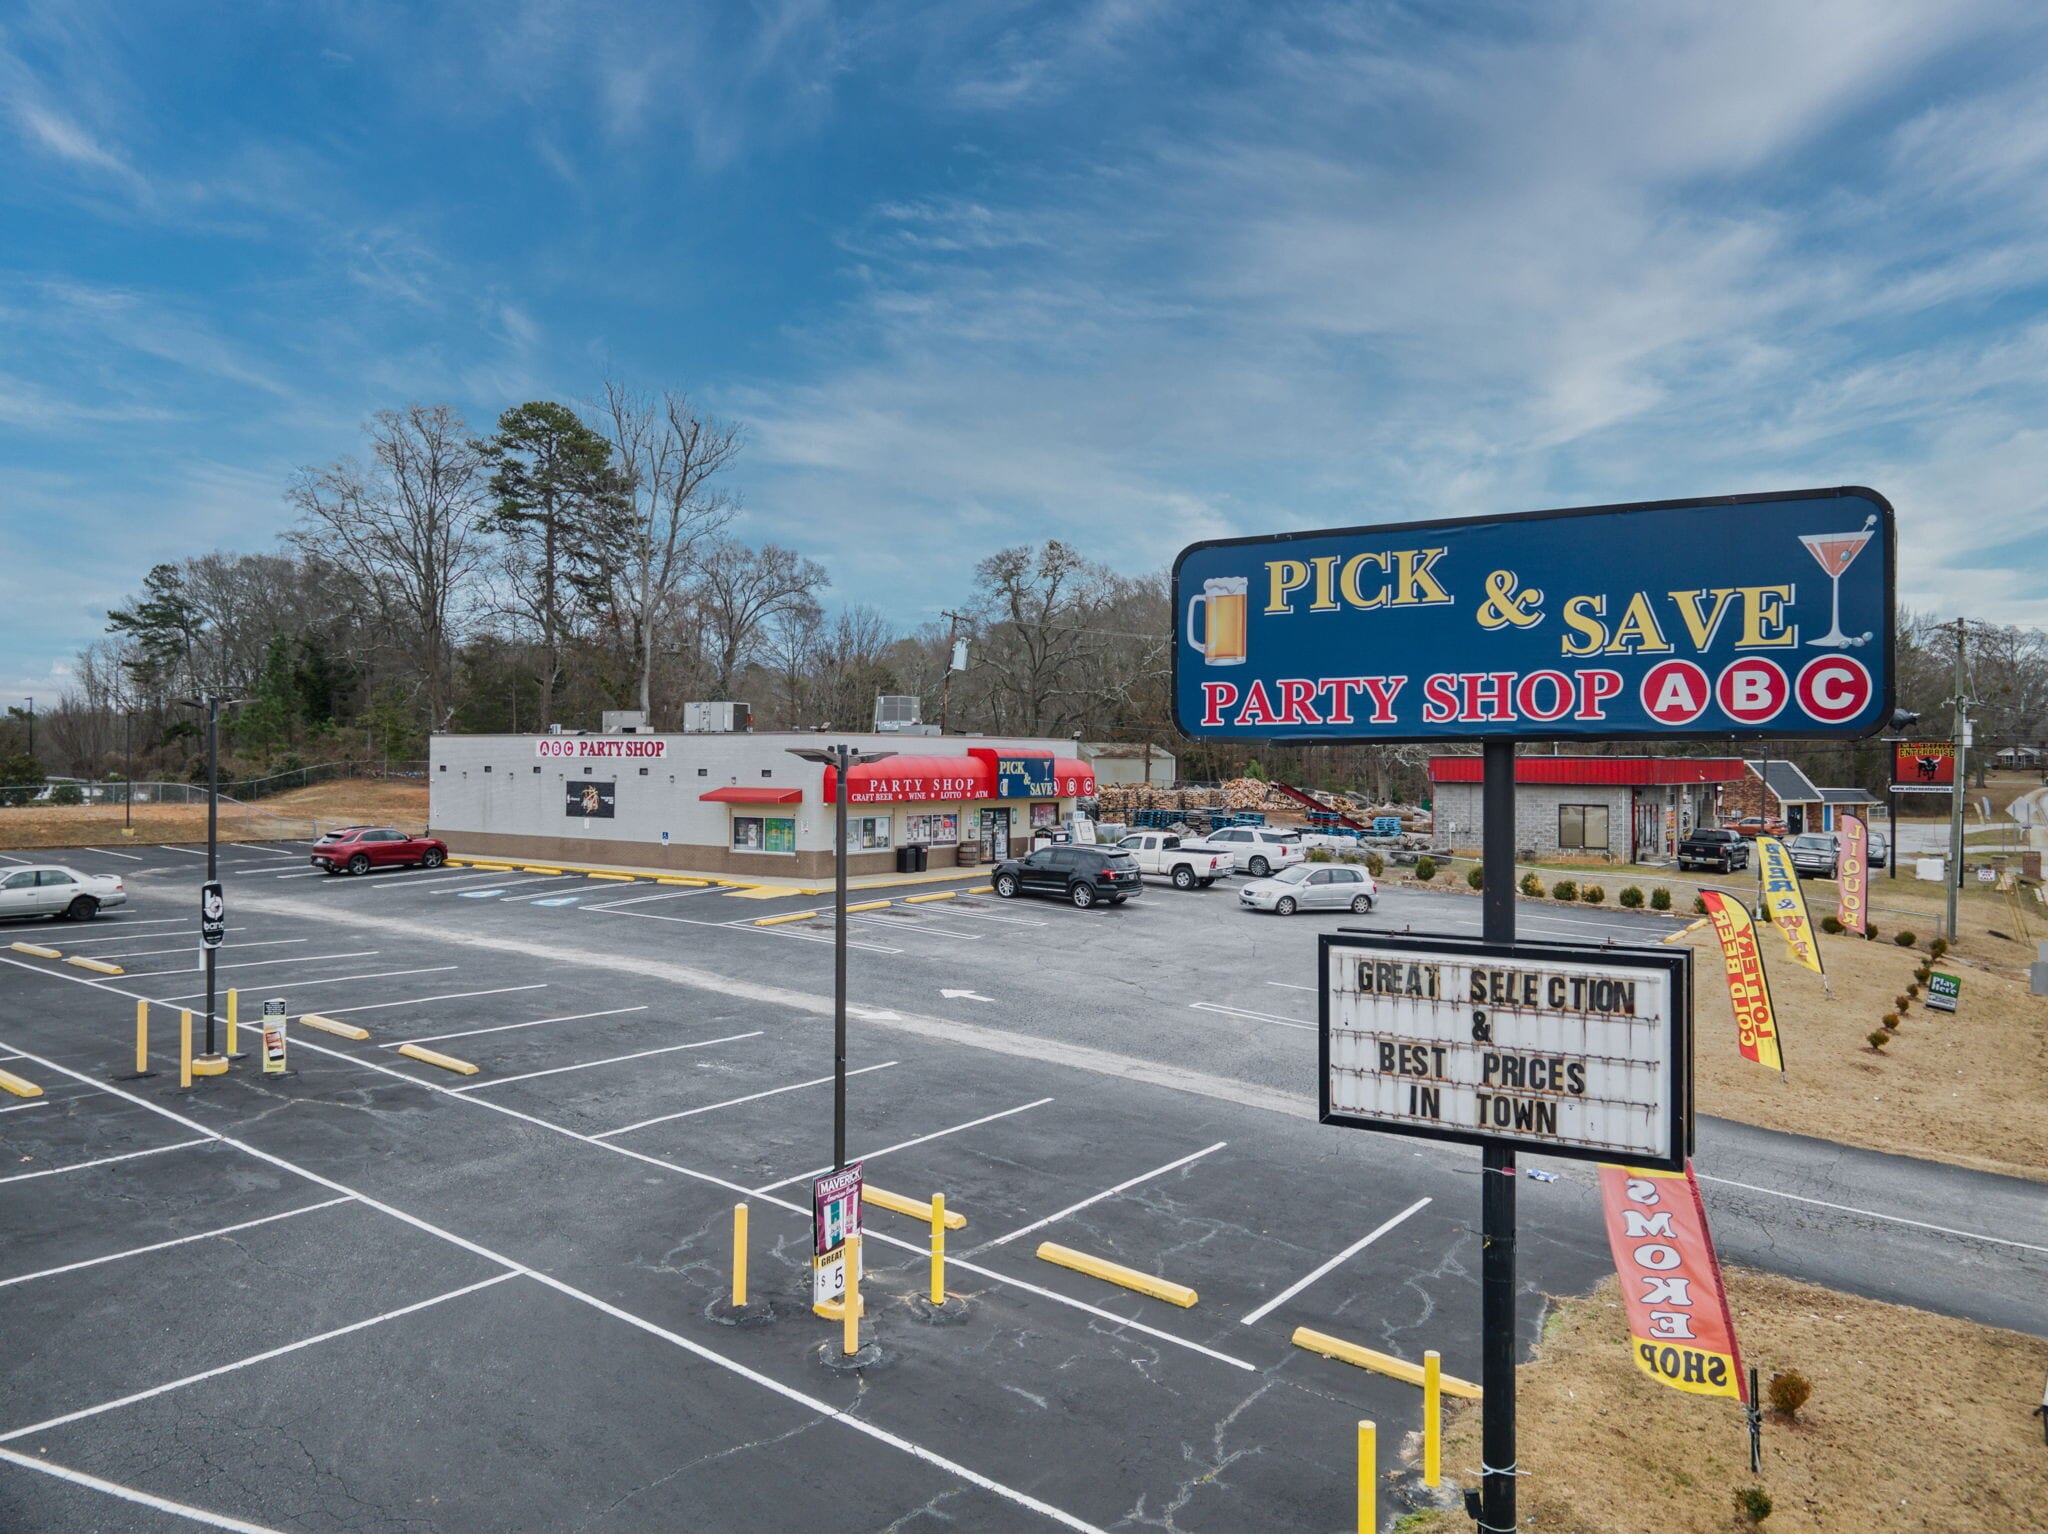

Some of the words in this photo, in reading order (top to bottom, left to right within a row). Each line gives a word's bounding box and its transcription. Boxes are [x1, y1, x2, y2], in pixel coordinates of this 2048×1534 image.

[1264, 547, 1454, 615] PICK
[1476, 569, 1546, 631] &
[1561, 583, 1799, 658] SAVE
[1200, 675, 1408, 726] PARTY
[1423, 669, 1624, 724] SHOP
[579, 741, 624, 757] PARTY
[625, 741, 664, 757] SHOP
[1899, 747, 1956, 758] ENTERPRISE
[999, 761, 1026, 774] PICK
[869, 779, 923, 792] PARTY
[933, 778, 974, 791] SHOP
[1024, 772, 1031, 785] &
[851, 793, 875, 802] CRAFT
[875, 792, 893, 801] BEER
[908, 791, 926, 800] WINE
[940, 791, 962, 799] LOTTO
[975, 790, 989, 798] ATM
[1030, 782, 1053, 796] SAVE
[1357, 961, 1440, 998] GREAT
[1470, 969, 1635, 1015] SELECTION
[1931, 983, 1958, 995] Here
[1932, 976, 1956, 989] Play
[1472, 1010, 1491, 1043] &
[1379, 1042, 1447, 1079] BEST
[1484, 1052, 1586, 1095] PRICES
[1409, 1085, 1441, 1119] IN
[1476, 1092, 1557, 1135] TOWN
[821, 1170, 860, 1194] MAVERICK
[821, 1249, 843, 1267] GREAT
